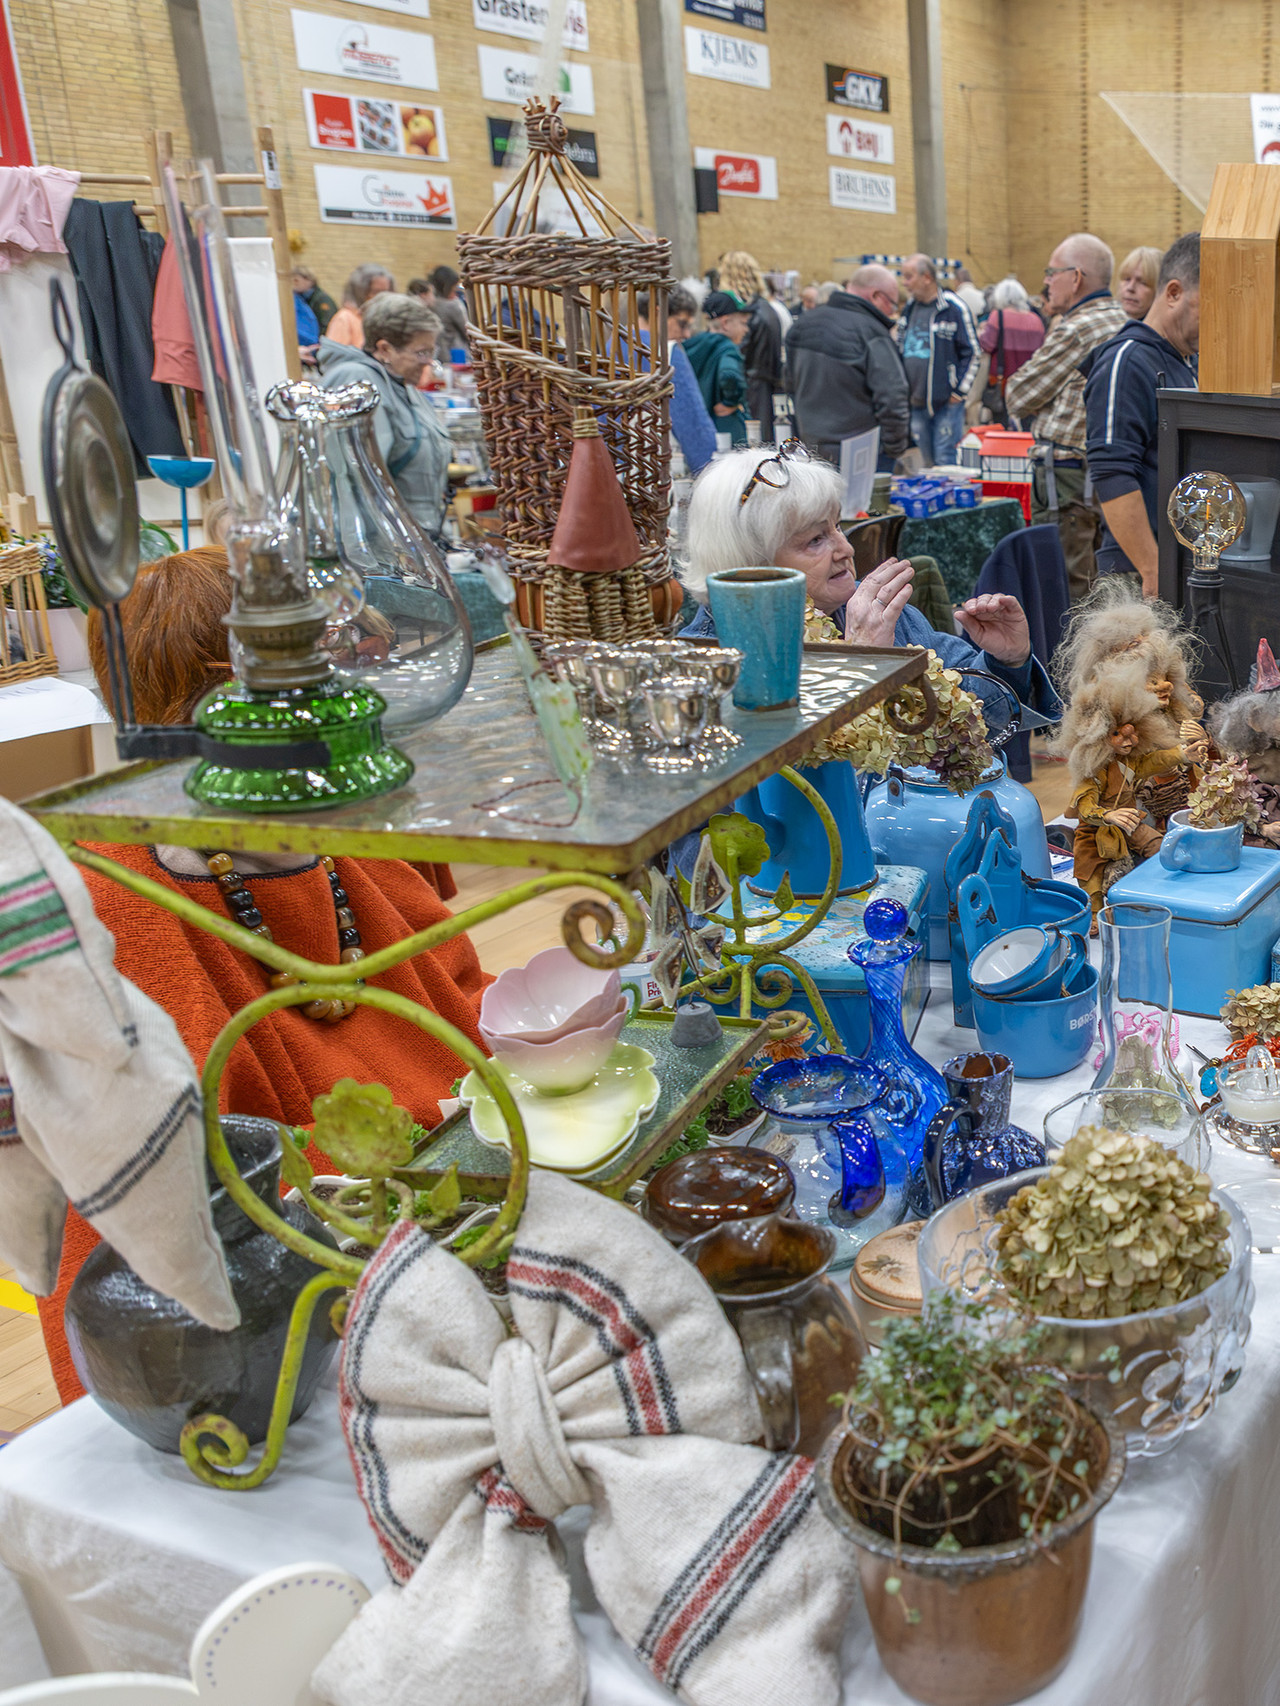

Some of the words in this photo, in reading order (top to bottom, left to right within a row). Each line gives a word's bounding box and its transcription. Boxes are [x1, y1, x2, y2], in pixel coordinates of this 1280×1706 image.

[701, 32, 758, 69] KJEMS
[835, 172, 891, 198] BRUHNS
[1070, 1009, 1096, 1030] BØRS
